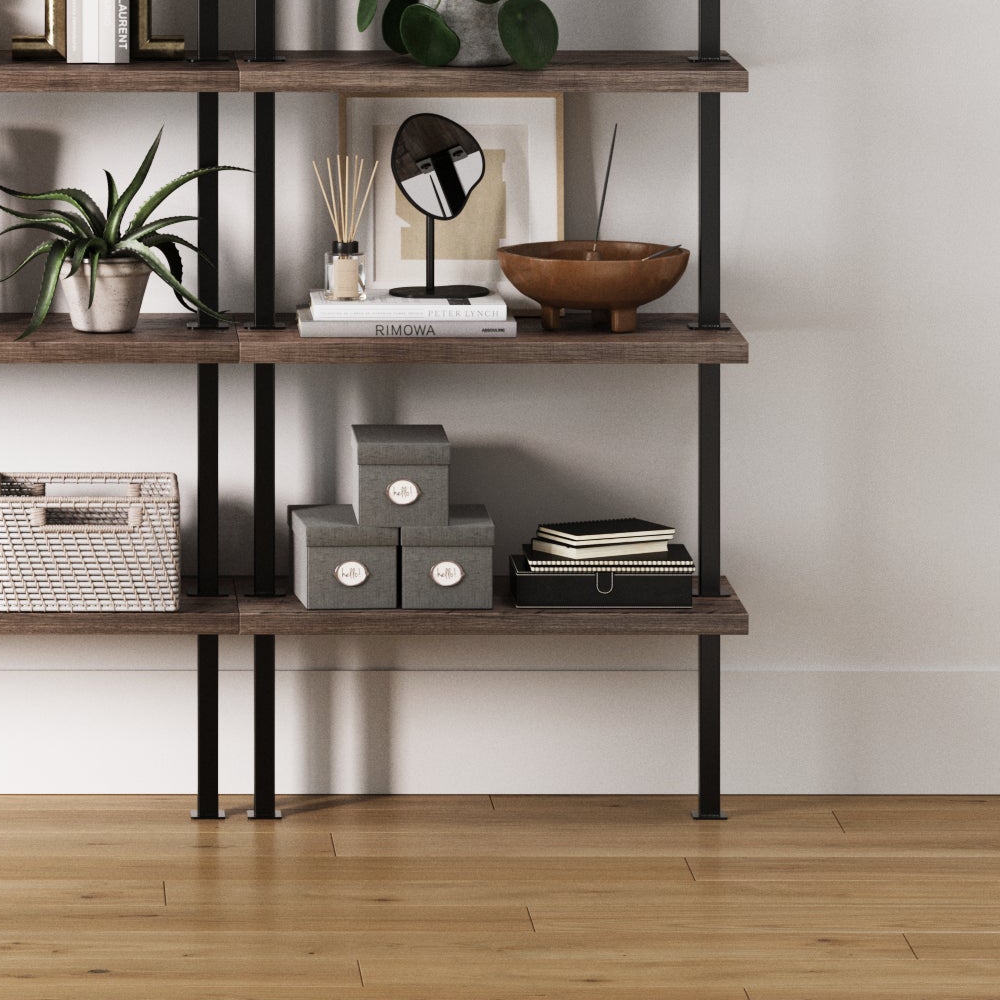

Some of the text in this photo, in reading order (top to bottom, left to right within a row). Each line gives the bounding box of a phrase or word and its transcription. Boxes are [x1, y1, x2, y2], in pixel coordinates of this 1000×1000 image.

[428, 309, 461, 318] PETER
[464, 309, 500, 318] LYNCH
[375, 324, 436, 336] RIMOWA
[392, 486, 413, 499] hello!
[341, 567, 361, 581] hello!
[436, 567, 456, 581] hello!
